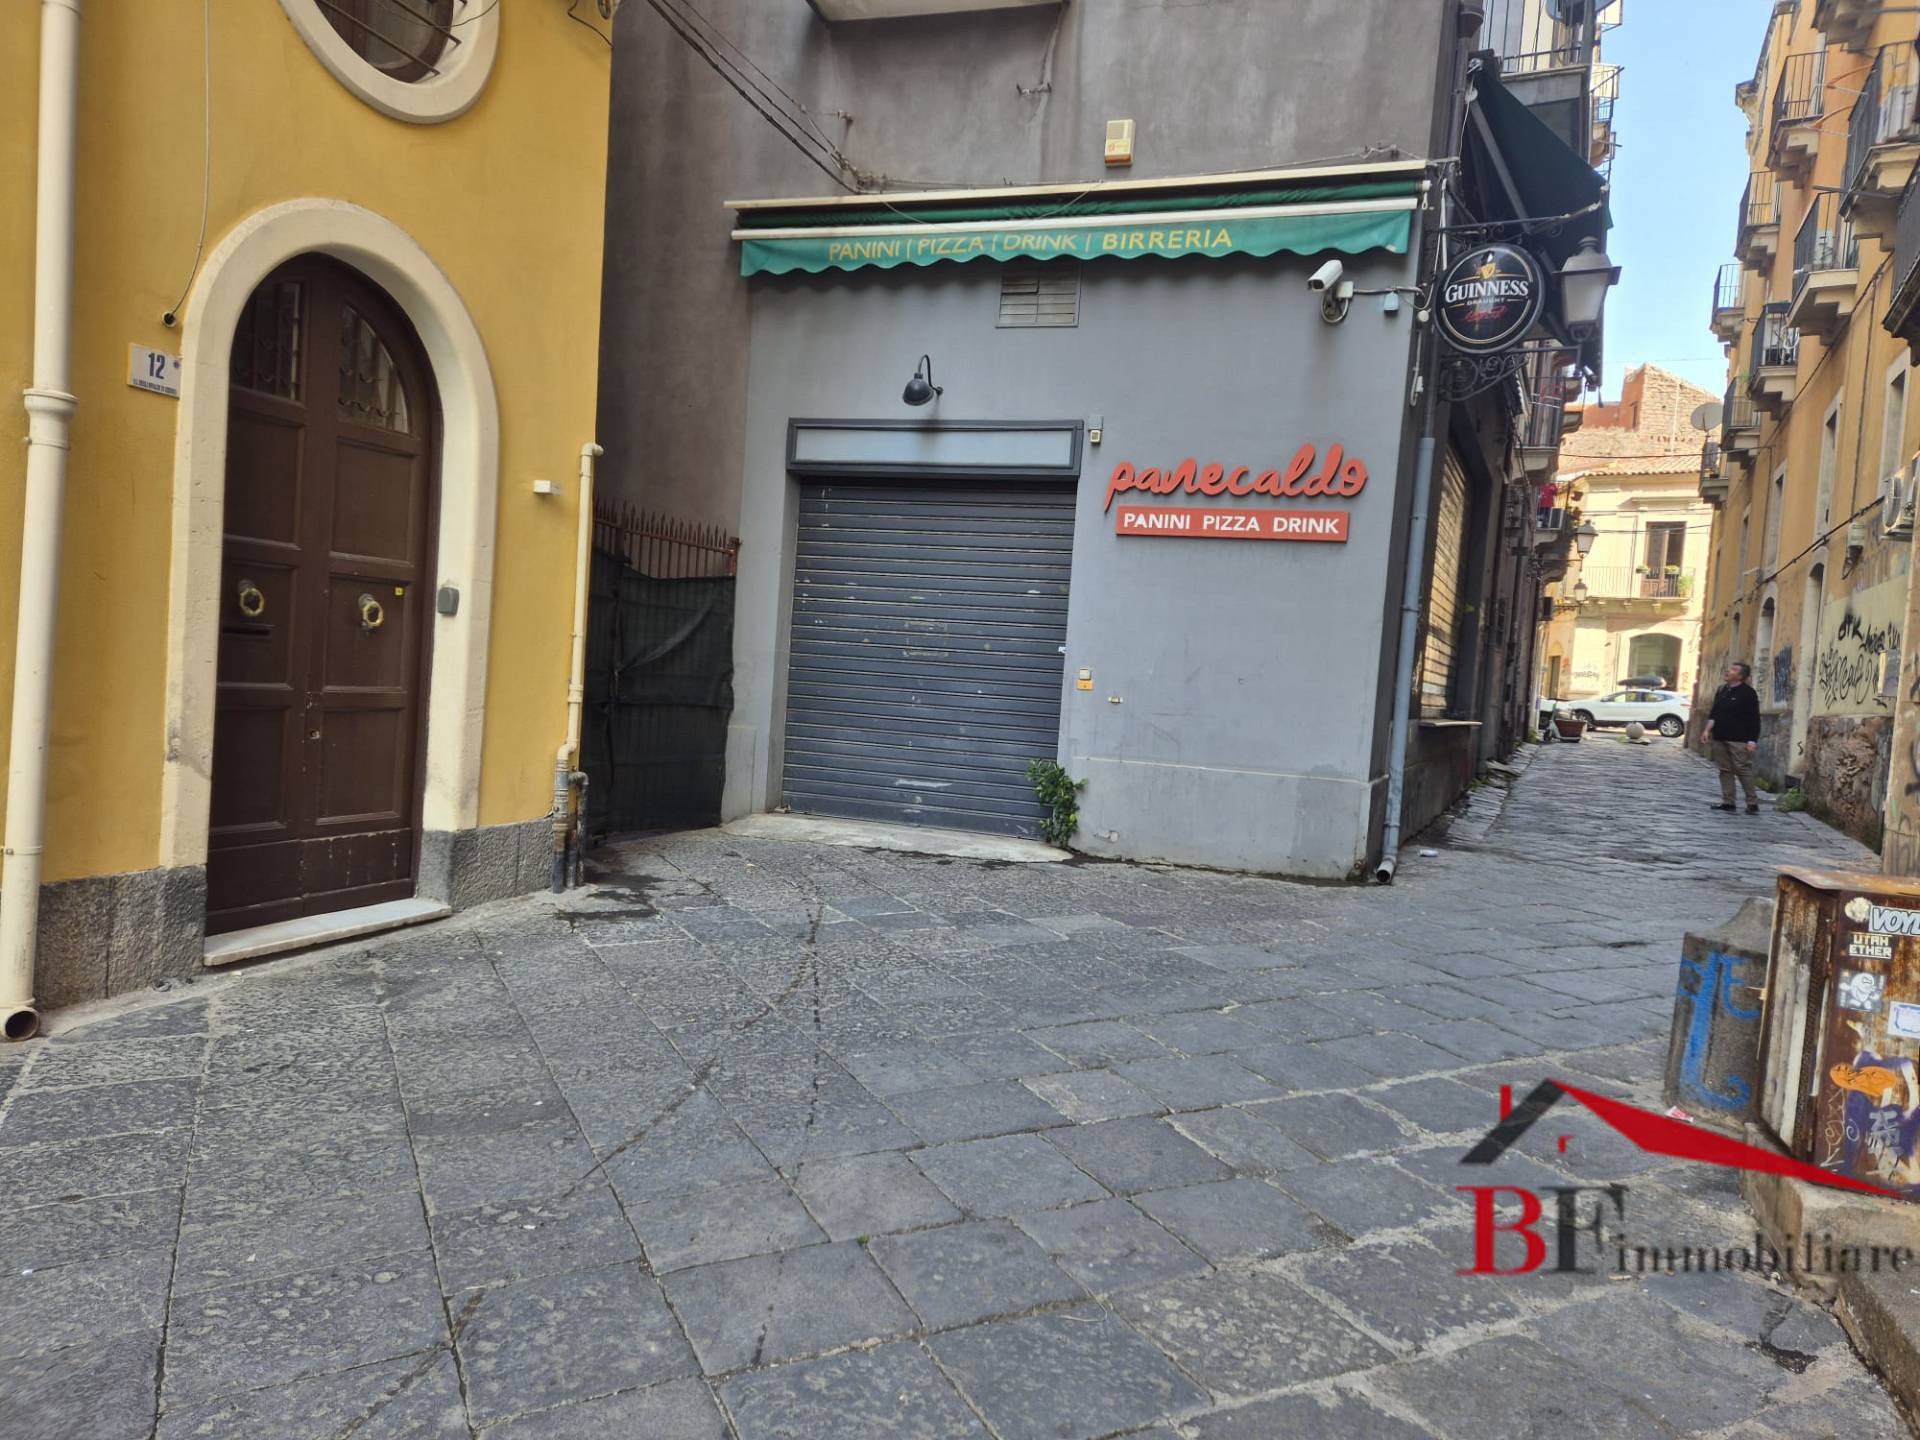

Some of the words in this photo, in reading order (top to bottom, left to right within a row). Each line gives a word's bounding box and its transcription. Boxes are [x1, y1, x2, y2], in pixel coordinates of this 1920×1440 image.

[828, 239, 900, 261] PANINI
[918, 236, 983, 256] PIZZA
[1003, 233, 1078, 251] DRINK
[1102, 227, 1233, 250] BIRRERIA
[1445, 280, 1529, 303] GUINNESS
[148, 352, 166, 379] 12
[1104, 443, 1368, 514] panecaldo
[1123, 512, 1191, 530] PANINI
[1202, 516, 1260, 532] PIZZA
[1273, 516, 1339, 535] DRINK
[1849, 943, 1892, 957] ETHER
[1853, 934, 1889, 946] UTAH
